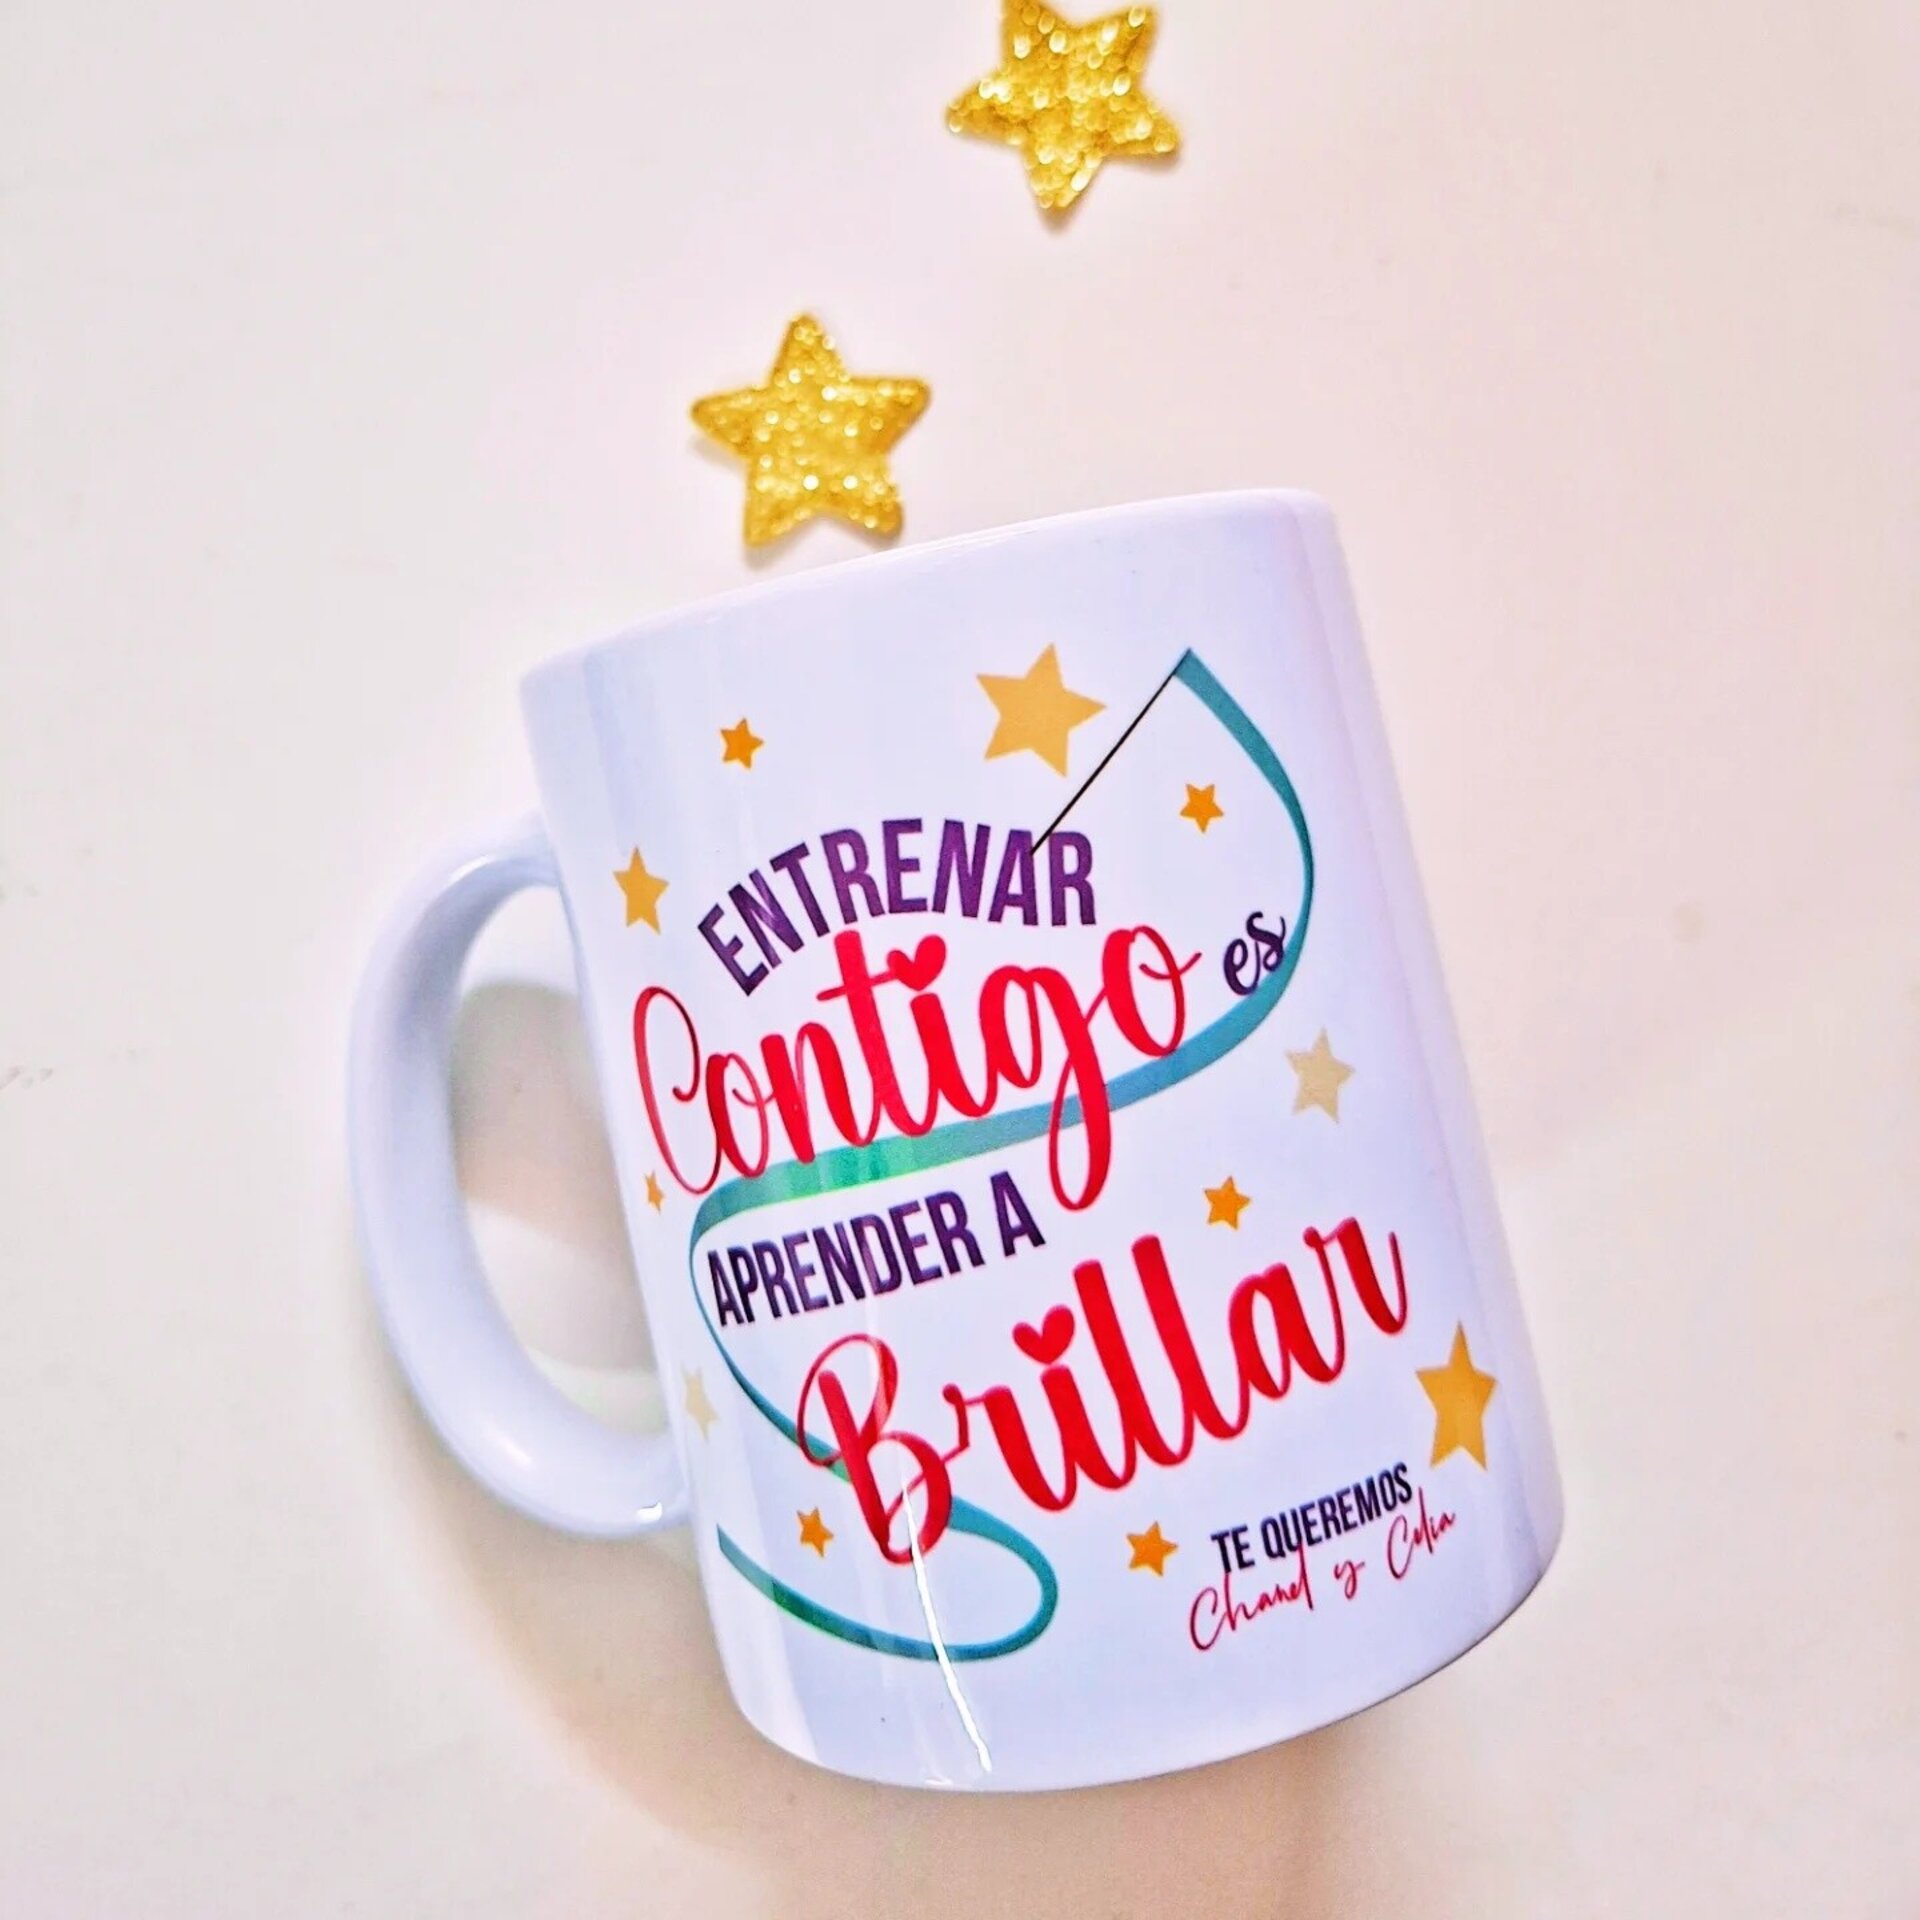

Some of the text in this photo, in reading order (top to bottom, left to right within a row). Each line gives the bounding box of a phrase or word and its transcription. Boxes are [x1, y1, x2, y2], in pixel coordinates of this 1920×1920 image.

[698, 818, 1097, 997] ENTRENAR
[633, 911, 1287, 1211] Contigo es
[707, 1170, 1046, 1327] APRENDER A
[796, 1216, 1408, 1566] Brillar
[1190, 1486, 1456, 1651] Chanel y Celia
[1210, 1461, 1413, 1574] TE QUEREMOS
